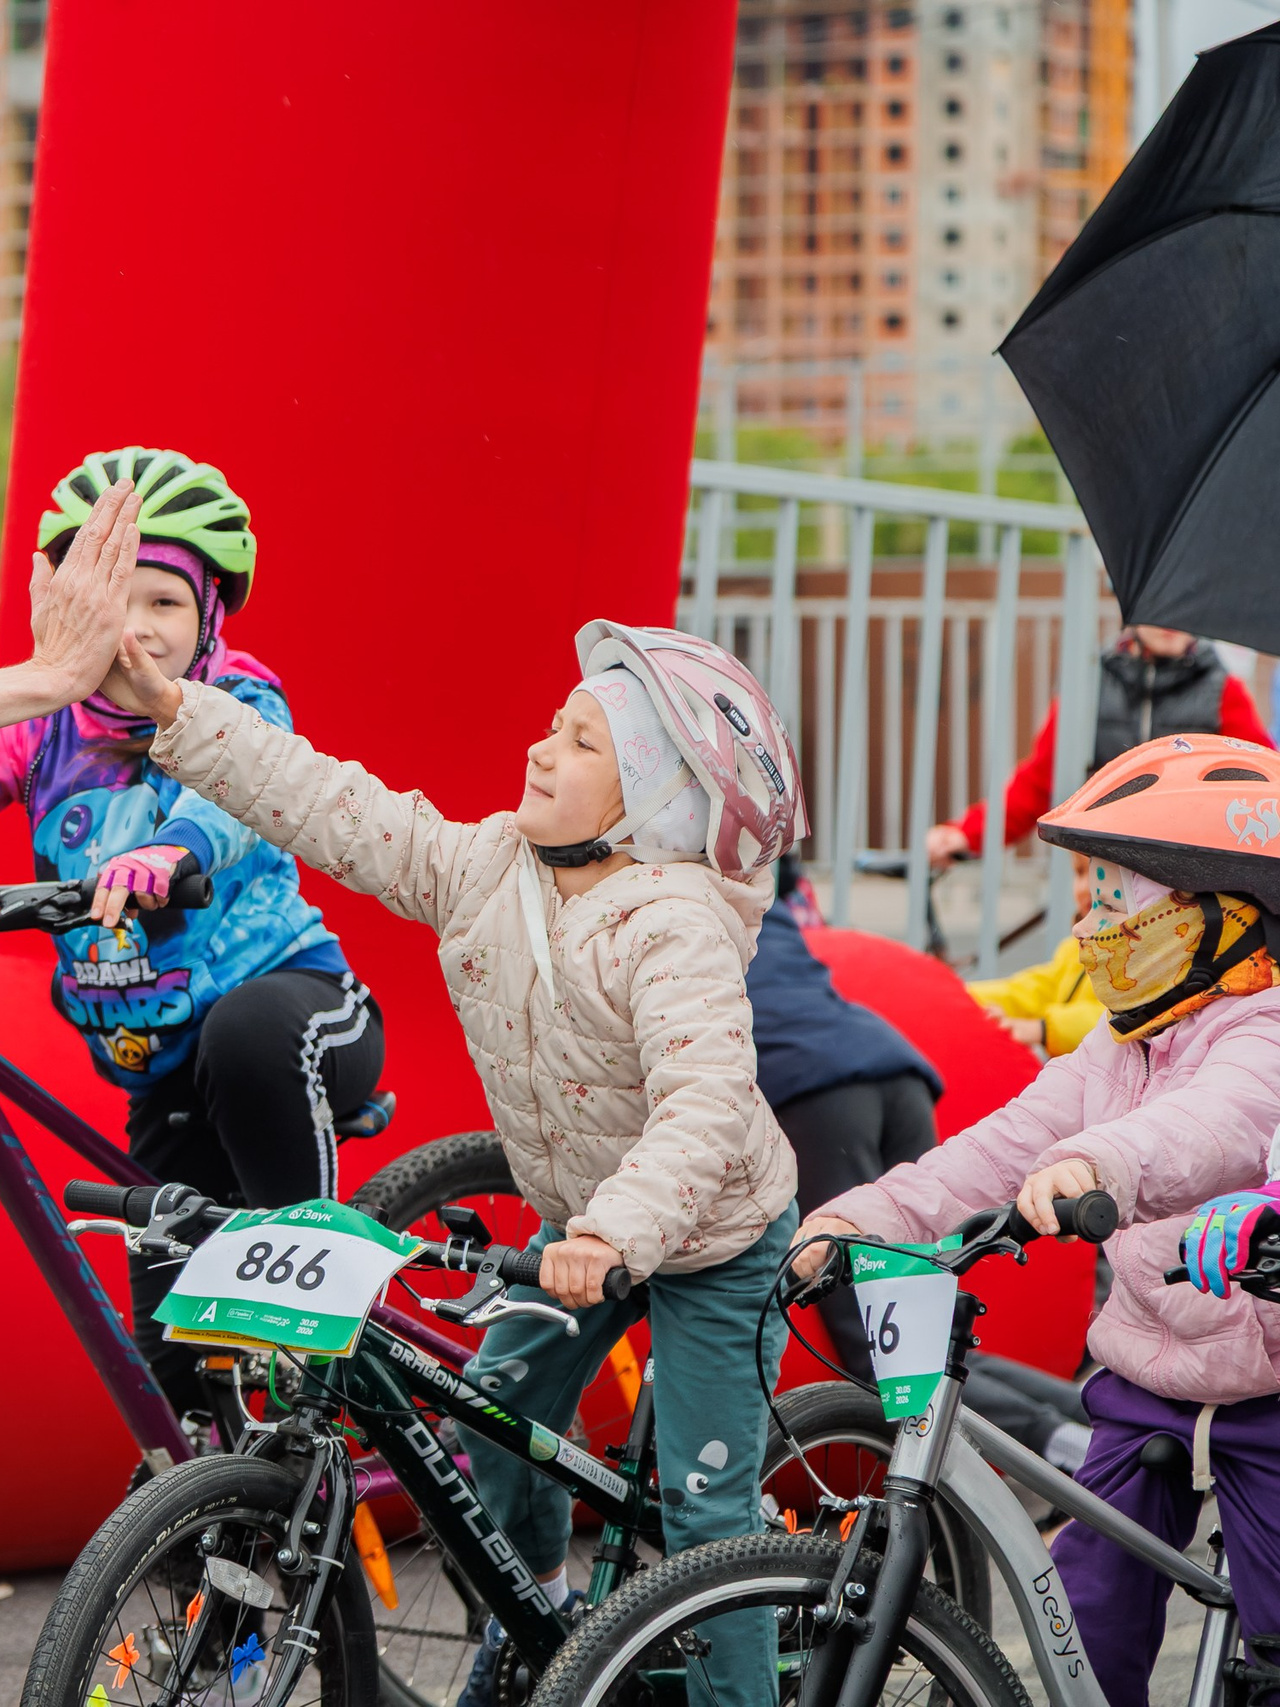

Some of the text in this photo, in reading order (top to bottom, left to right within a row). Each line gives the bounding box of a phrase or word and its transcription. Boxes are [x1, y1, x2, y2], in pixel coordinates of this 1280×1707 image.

[72, 956, 158, 986] BRAWL
[61, 968, 192, 1030] STARS
[302, 1209, 333, 1222] Звук
[236, 1241, 331, 1291] 866
[296, 1326, 314, 1335] 2026
[299, 1318, 319, 1327] 30.05
[389, 1341, 459, 1395] DRAGON
